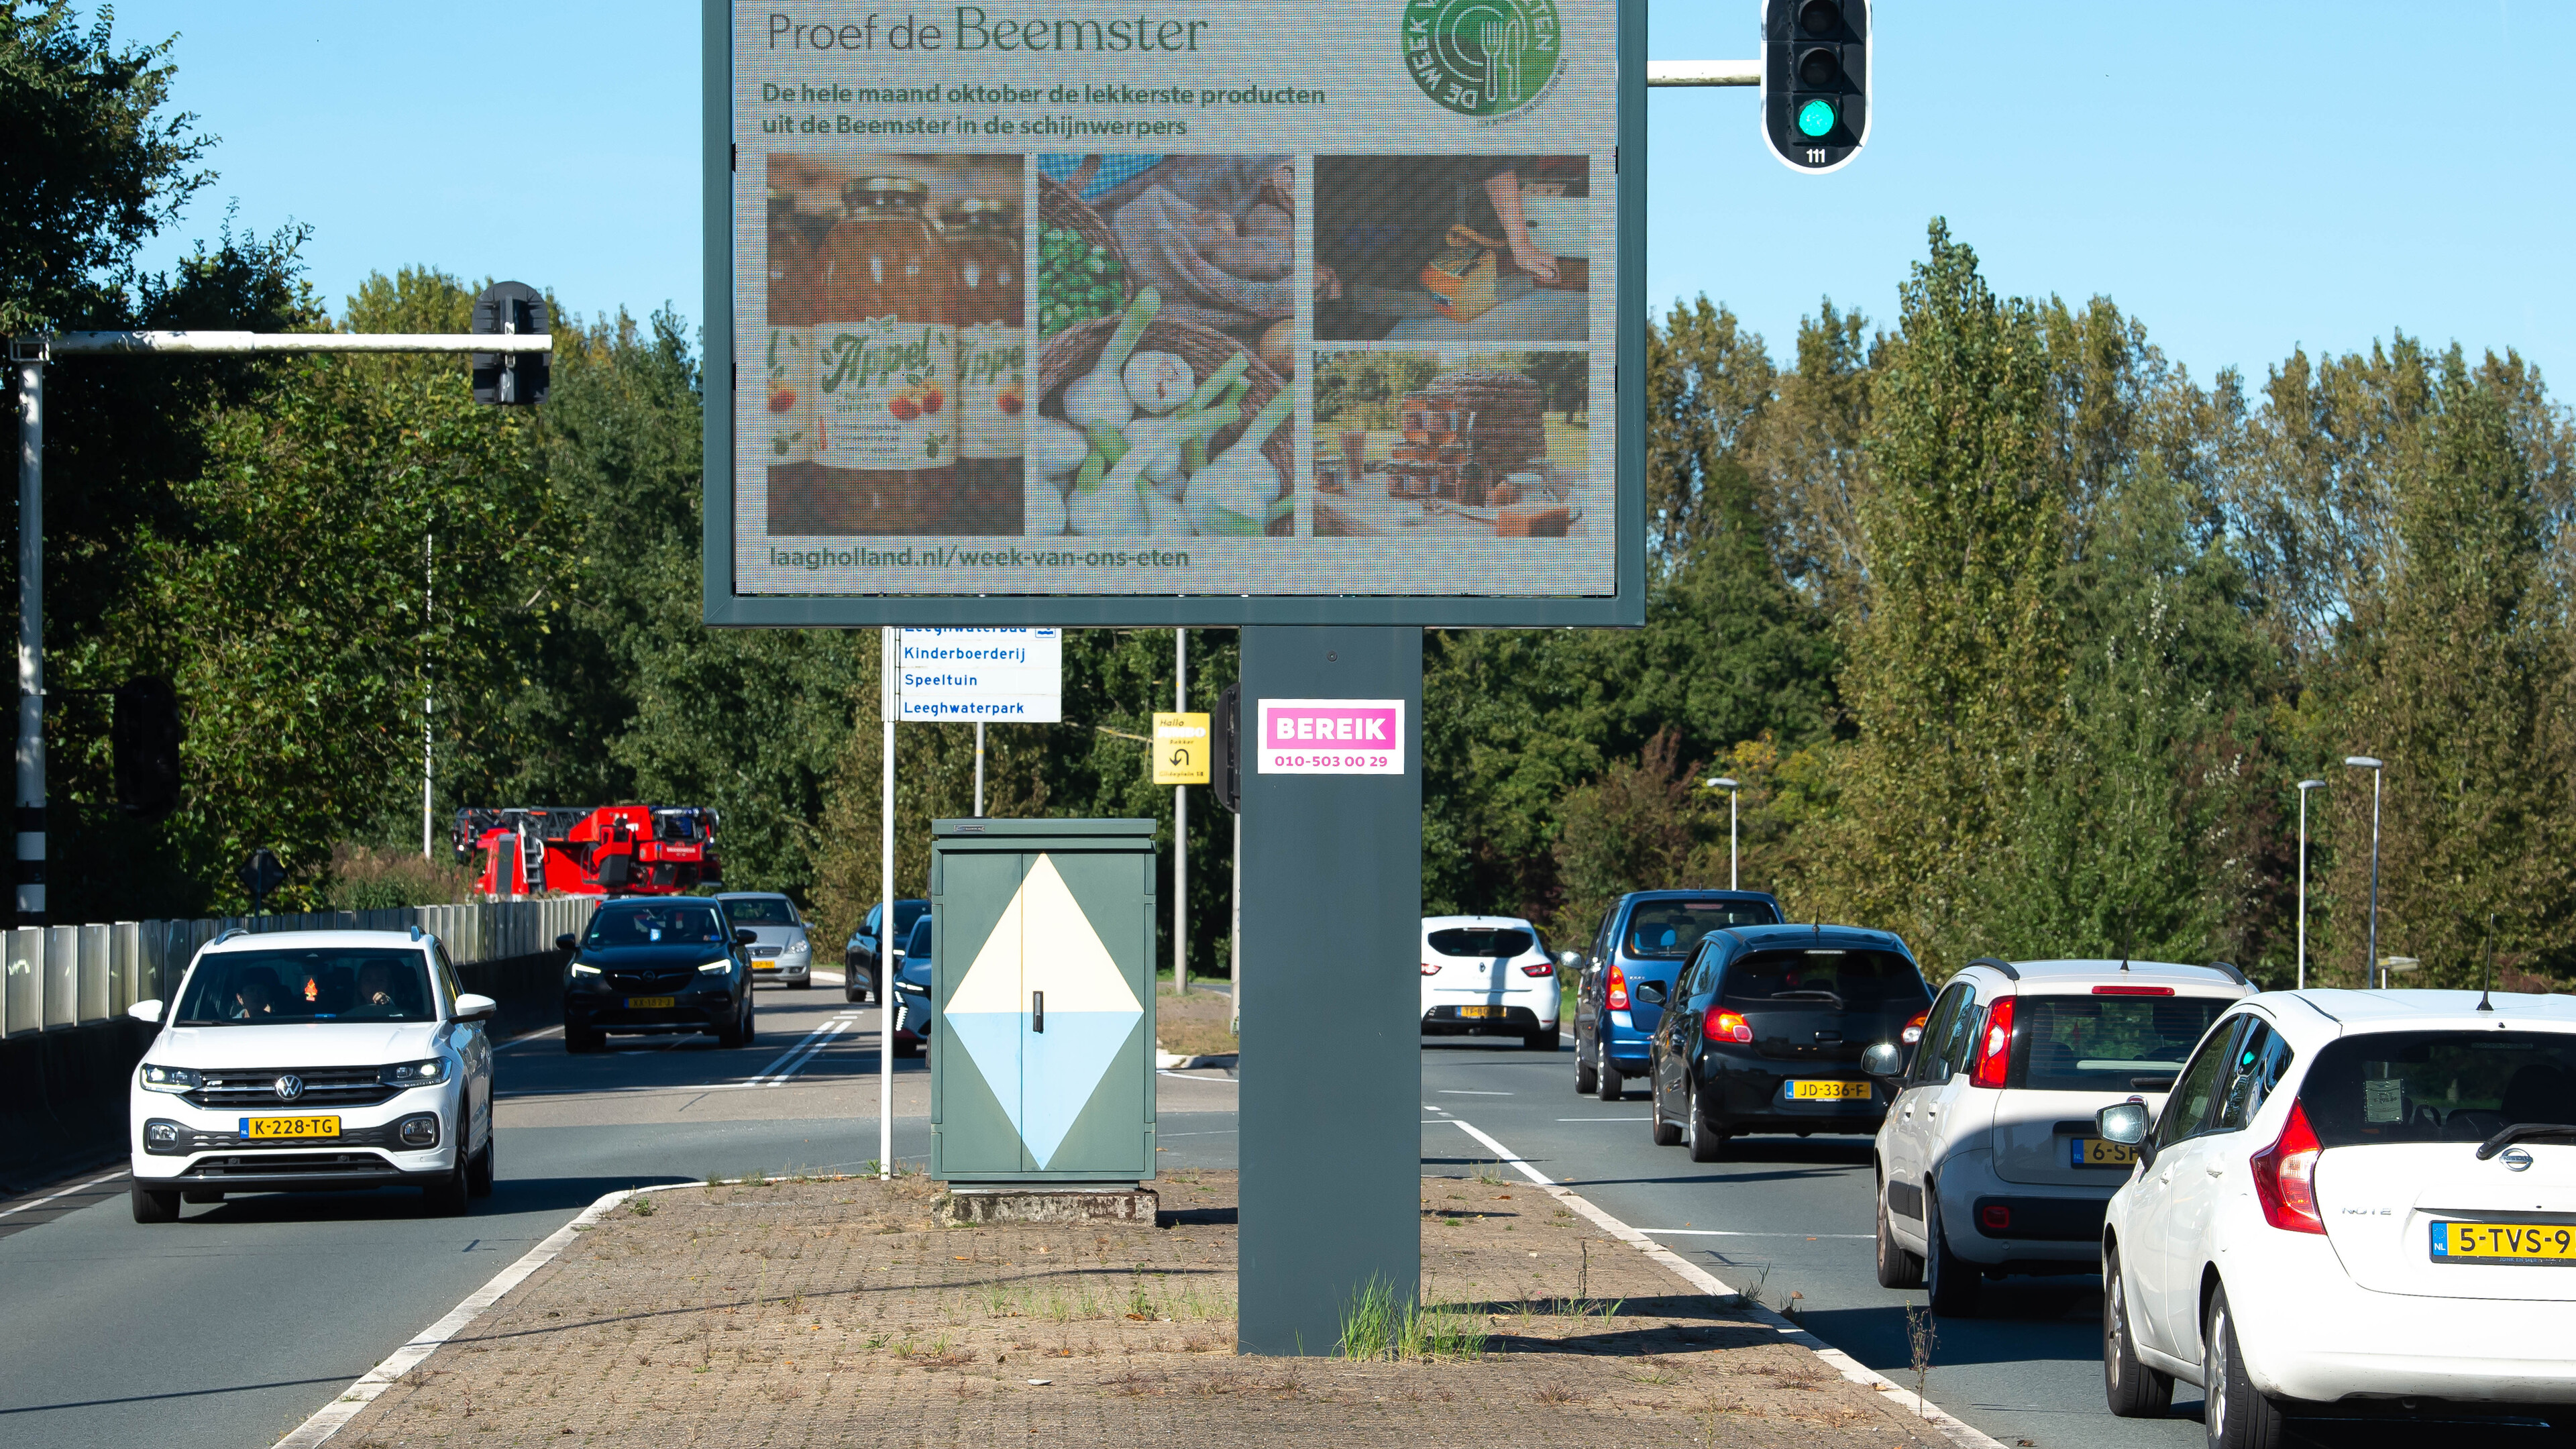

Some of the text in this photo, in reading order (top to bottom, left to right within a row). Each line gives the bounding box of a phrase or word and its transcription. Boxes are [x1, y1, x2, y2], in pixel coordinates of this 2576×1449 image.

[769, 6, 1208, 51] Proef de Beemster
[1409, 16, 1443, 92] WEEK
[763, 83, 1326, 109] De hele maand oktober de lekkerste producten
[1443, 82, 1478, 109] DE
[763, 115, 1187, 140] uit de Beemster in de schijnwerpers
[1806, 148, 1826, 163] 111
[820, 326, 932, 394] Appel
[770, 545, 1189, 570] laagholland.nl/week-van-ons-eten
[905, 647, 1025, 663] Kinderboerderij
[905, 674, 977, 688] Speeltuin
[904, 702, 1024, 716] Leeghwaterpark
[1160, 718, 1185, 727] Hallo
[1277, 718, 1387, 741] BEREIK
[1275, 755, 1388, 767] 010-503 00 29
[1800, 1083, 1864, 1097] JD-336-F
[255, 1119, 333, 1135] K-228-TG
[2342, 1207, 2392, 1216] NOTE
[2434, 1242, 2447, 1251] NL
[2460, 1228, 2576, 1253] 5-TVS-9
